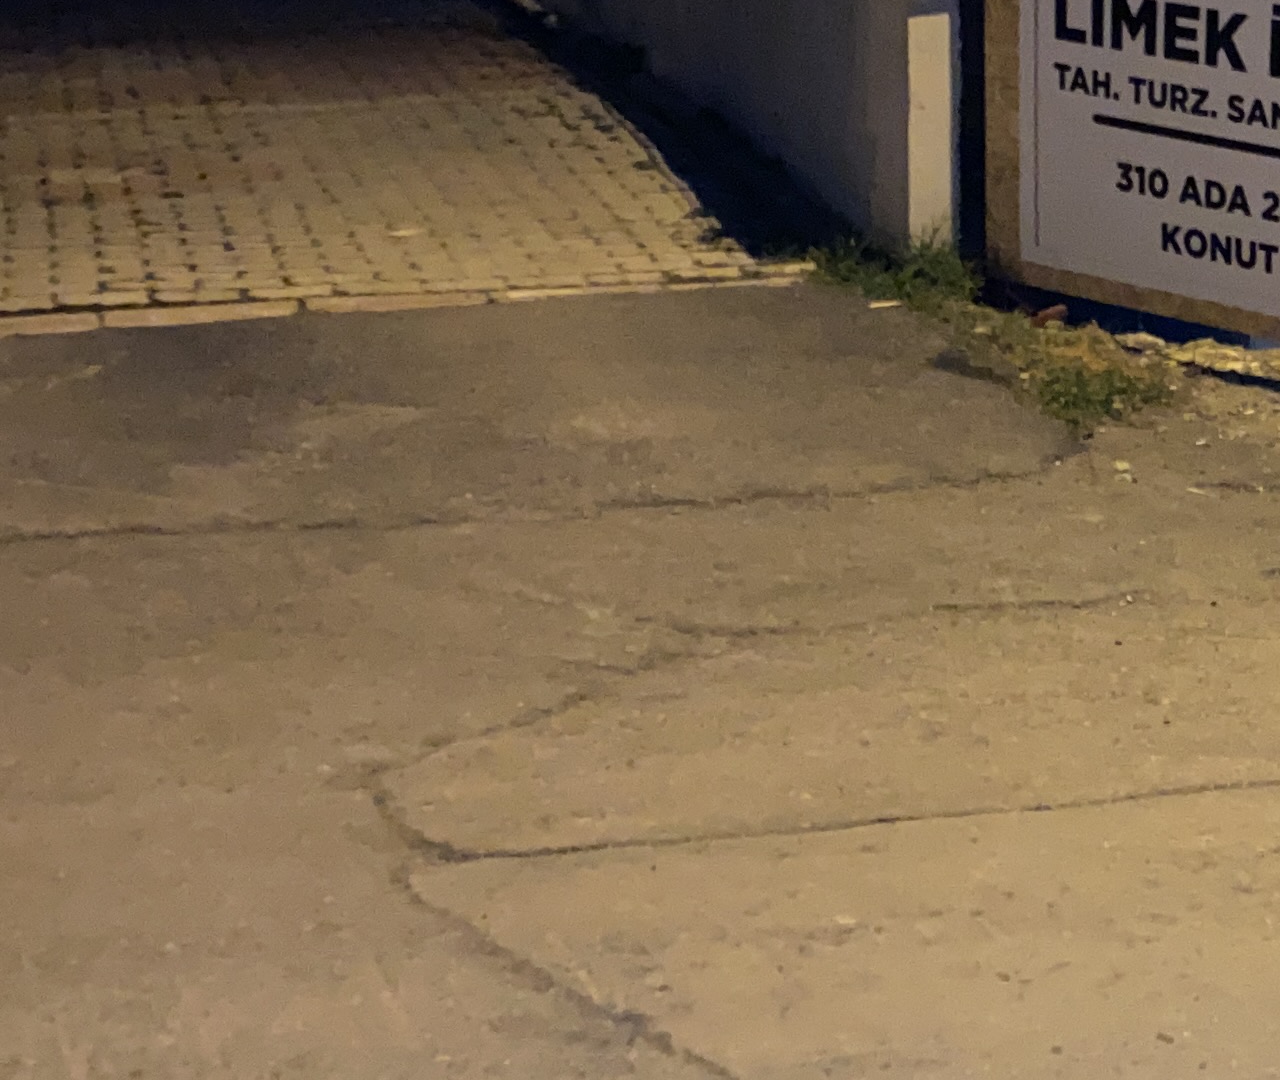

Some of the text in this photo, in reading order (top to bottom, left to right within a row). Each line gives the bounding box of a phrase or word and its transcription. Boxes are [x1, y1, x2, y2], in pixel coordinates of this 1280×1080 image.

[1053, 62, 1120, 102] TAH.
[1129, 76, 1218, 119] TURZ.
[1115, 161, 1169, 199] 310
[1179, 175, 1252, 218] ADA
[1160, 223, 1279, 275] KONUT
